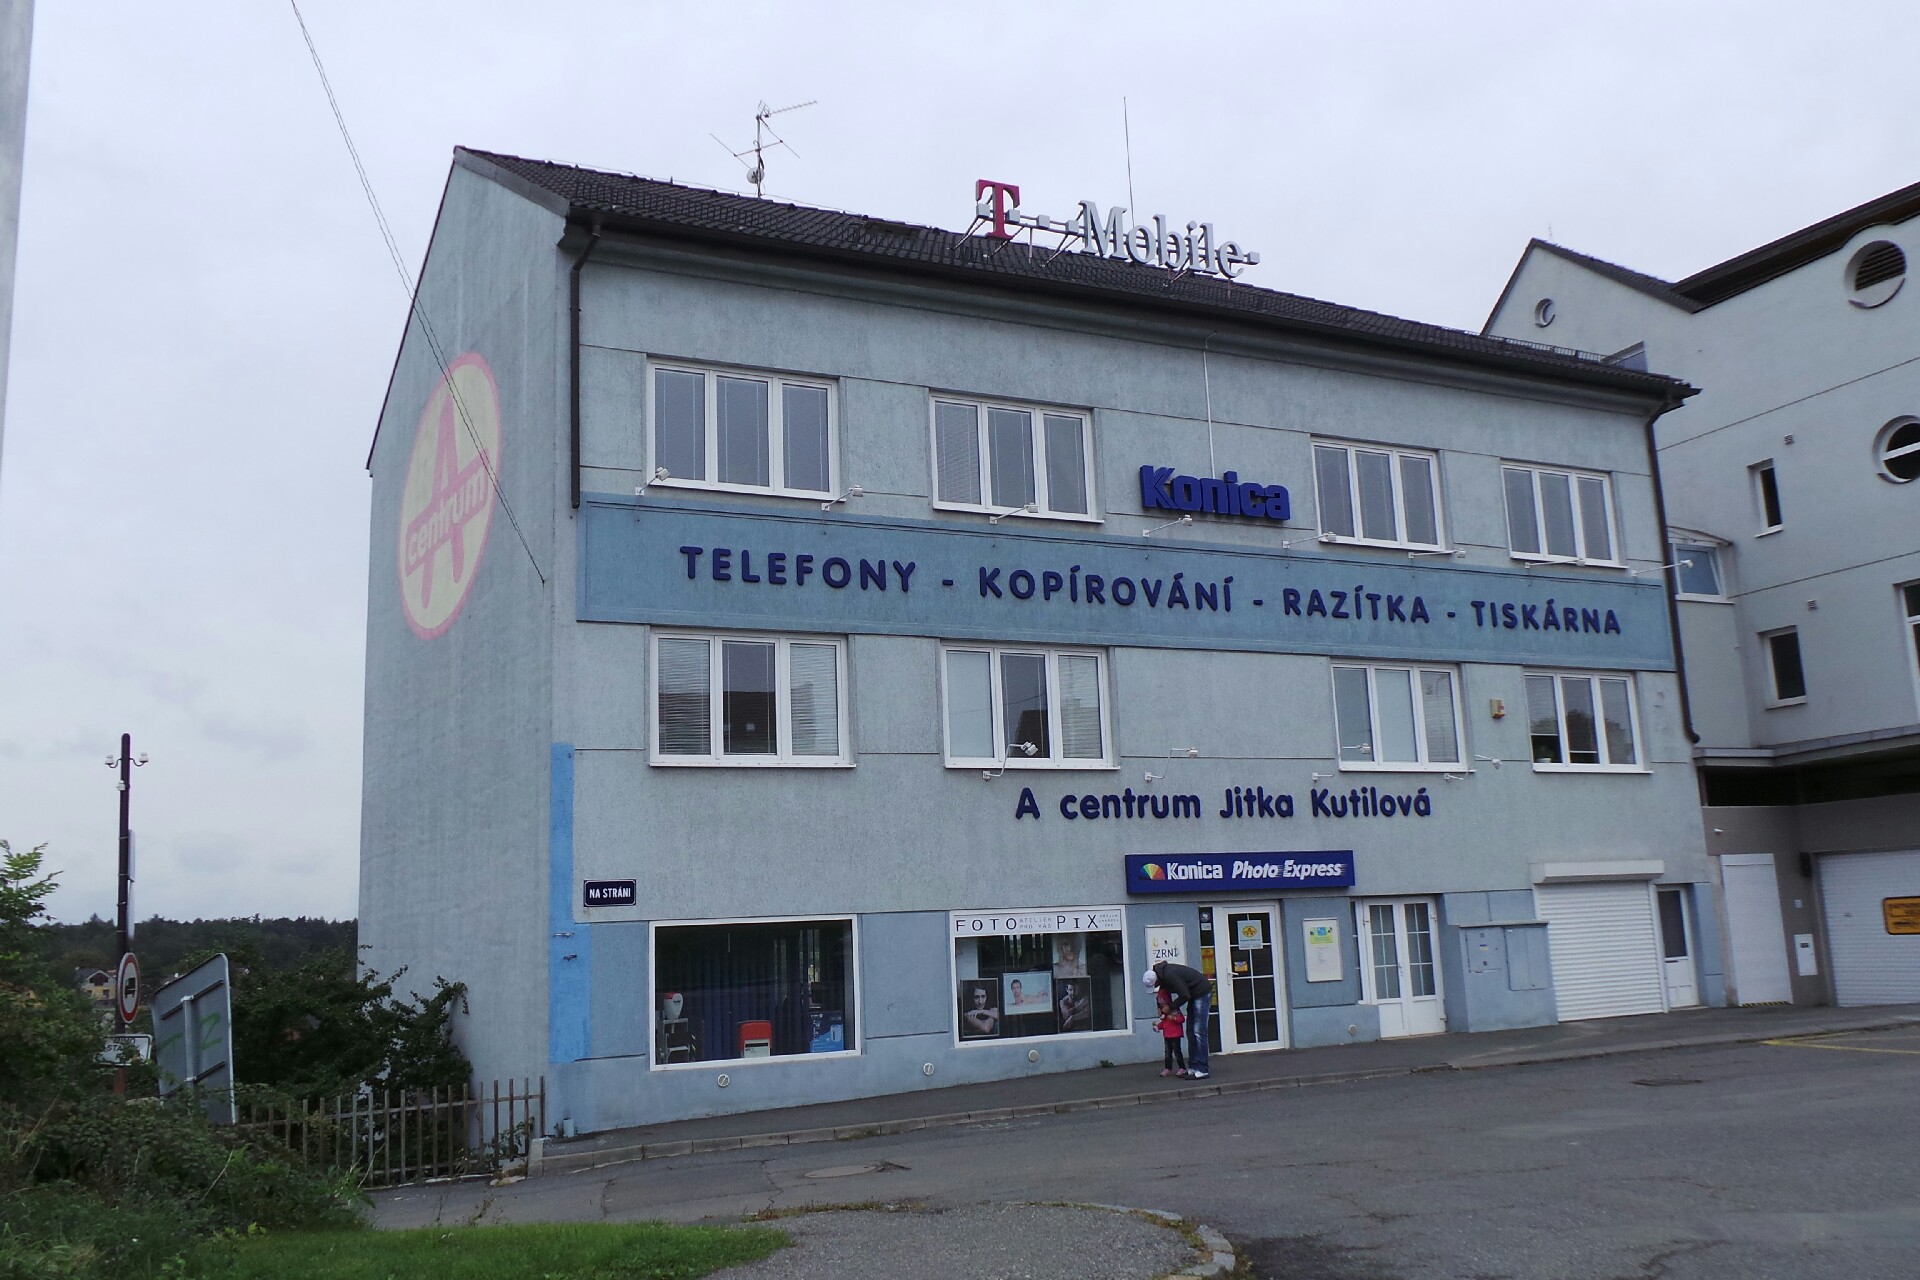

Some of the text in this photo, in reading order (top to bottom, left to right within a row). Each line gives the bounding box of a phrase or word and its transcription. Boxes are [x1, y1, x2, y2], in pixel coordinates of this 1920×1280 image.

[1139, 464, 1291, 521] Konica
[679, 545, 917, 593] TELEFONY
[979, 564, 1234, 612] KOPÍROVÁNÍ
[1282, 584, 1430, 625] RAZÍTKA
[1470, 598, 1622, 635] TISKÁRNA
[1014, 786, 1432, 820] A centrum Jitka Kutilová
[1166, 859, 1344, 881] Konica Photo Express
[589, 886, 631, 899] NA STRÁNI
[955, 917, 1017, 932] FOTO
